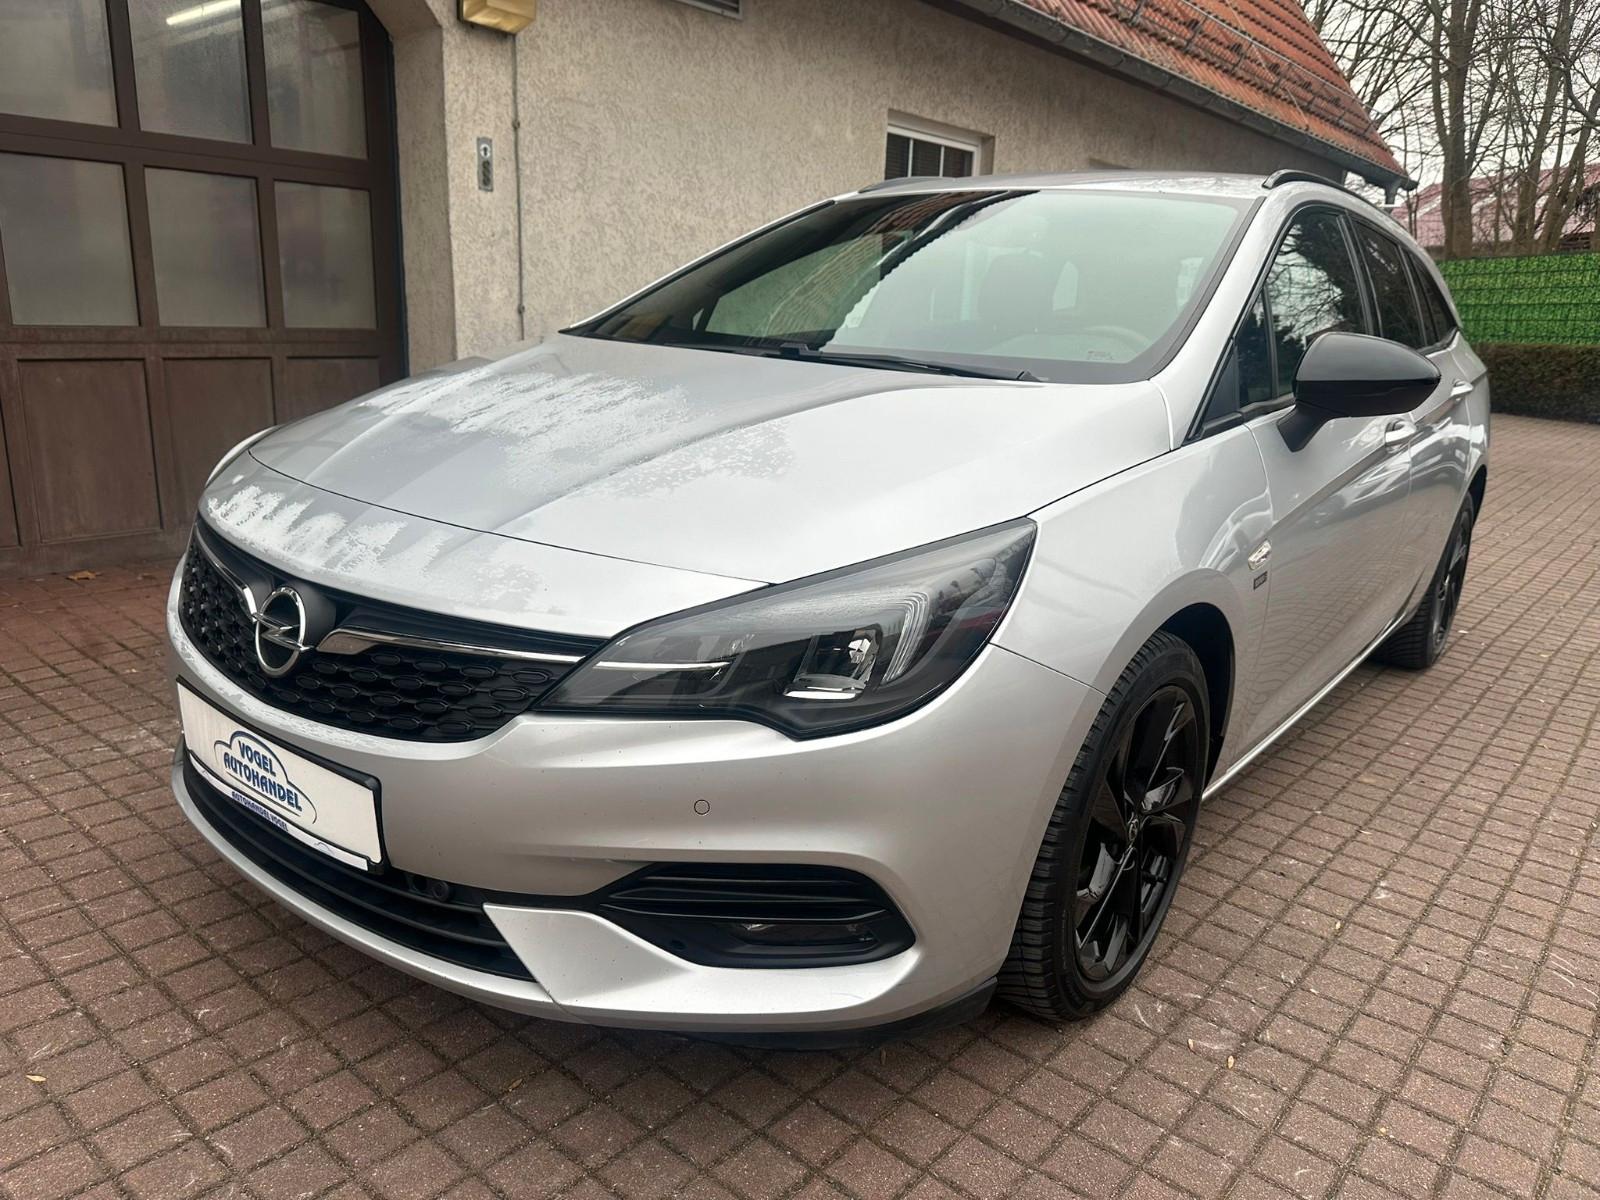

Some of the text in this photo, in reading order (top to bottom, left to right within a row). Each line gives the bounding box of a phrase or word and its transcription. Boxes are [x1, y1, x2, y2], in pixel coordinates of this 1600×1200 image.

[238, 740, 276, 777] VOGEL
[223, 752, 302, 812] AUTOHANDEL
[231, 791, 289, 832] AUTOHANDEL VOGEL
